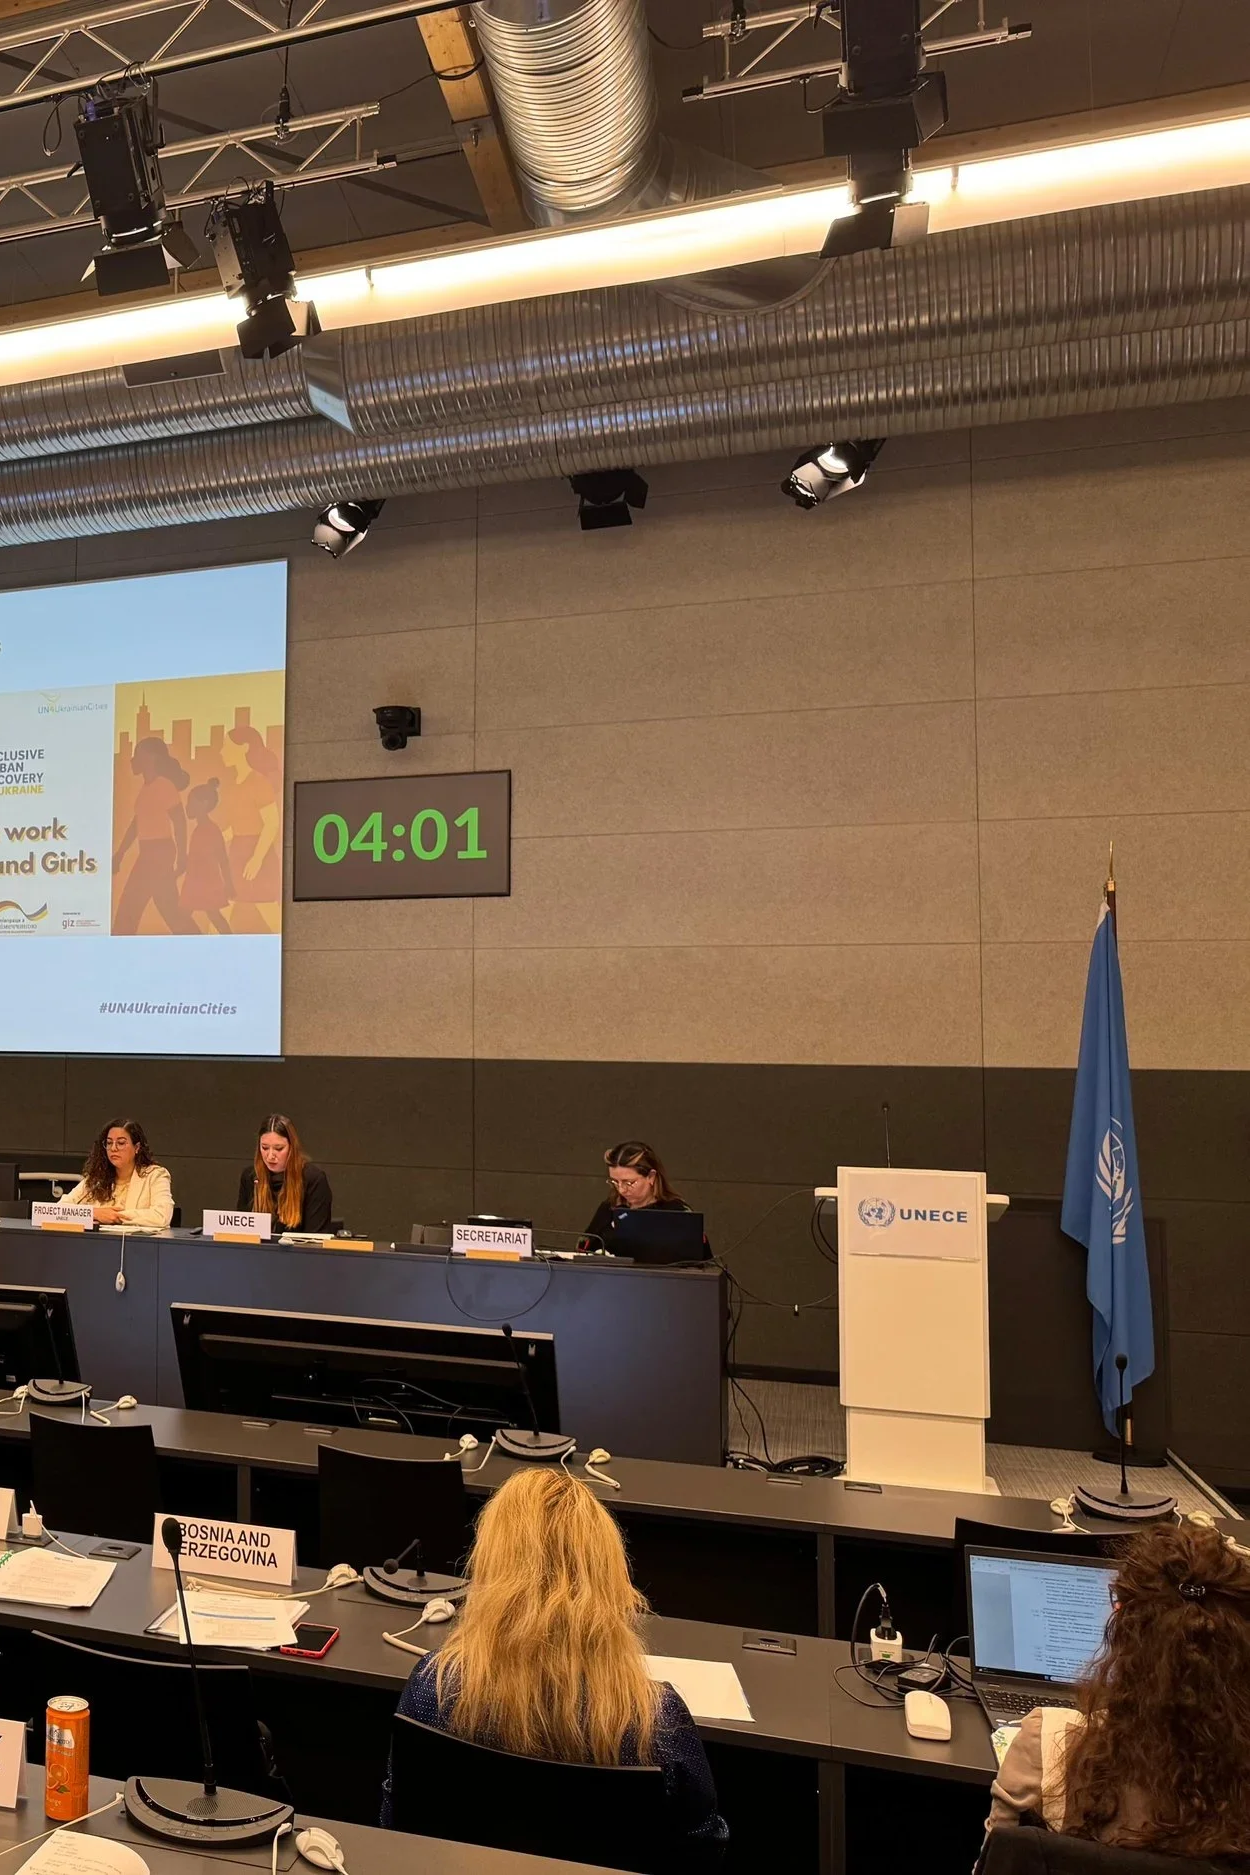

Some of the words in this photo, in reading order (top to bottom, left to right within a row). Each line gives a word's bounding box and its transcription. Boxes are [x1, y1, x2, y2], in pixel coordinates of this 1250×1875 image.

[5, 817, 68, 842] work
[313, 807, 487, 864] 04:01
[41, 850, 98, 874] Girls
[100, 1002, 237, 1014] #UN4UkrainianCities
[34, 1206, 60, 1215] PROJECT
[62, 1208, 91, 1217] MANAGER
[900, 1209, 968, 1223] UNECE
[219, 1215, 255, 1228] UNECE
[456, 1229, 527, 1244] SECRETARIAT
[179, 1523, 235, 1544] BOSNIA
[238, 1530, 271, 1548] AND
[178, 1541, 278, 1568] ERZEGOVINA
